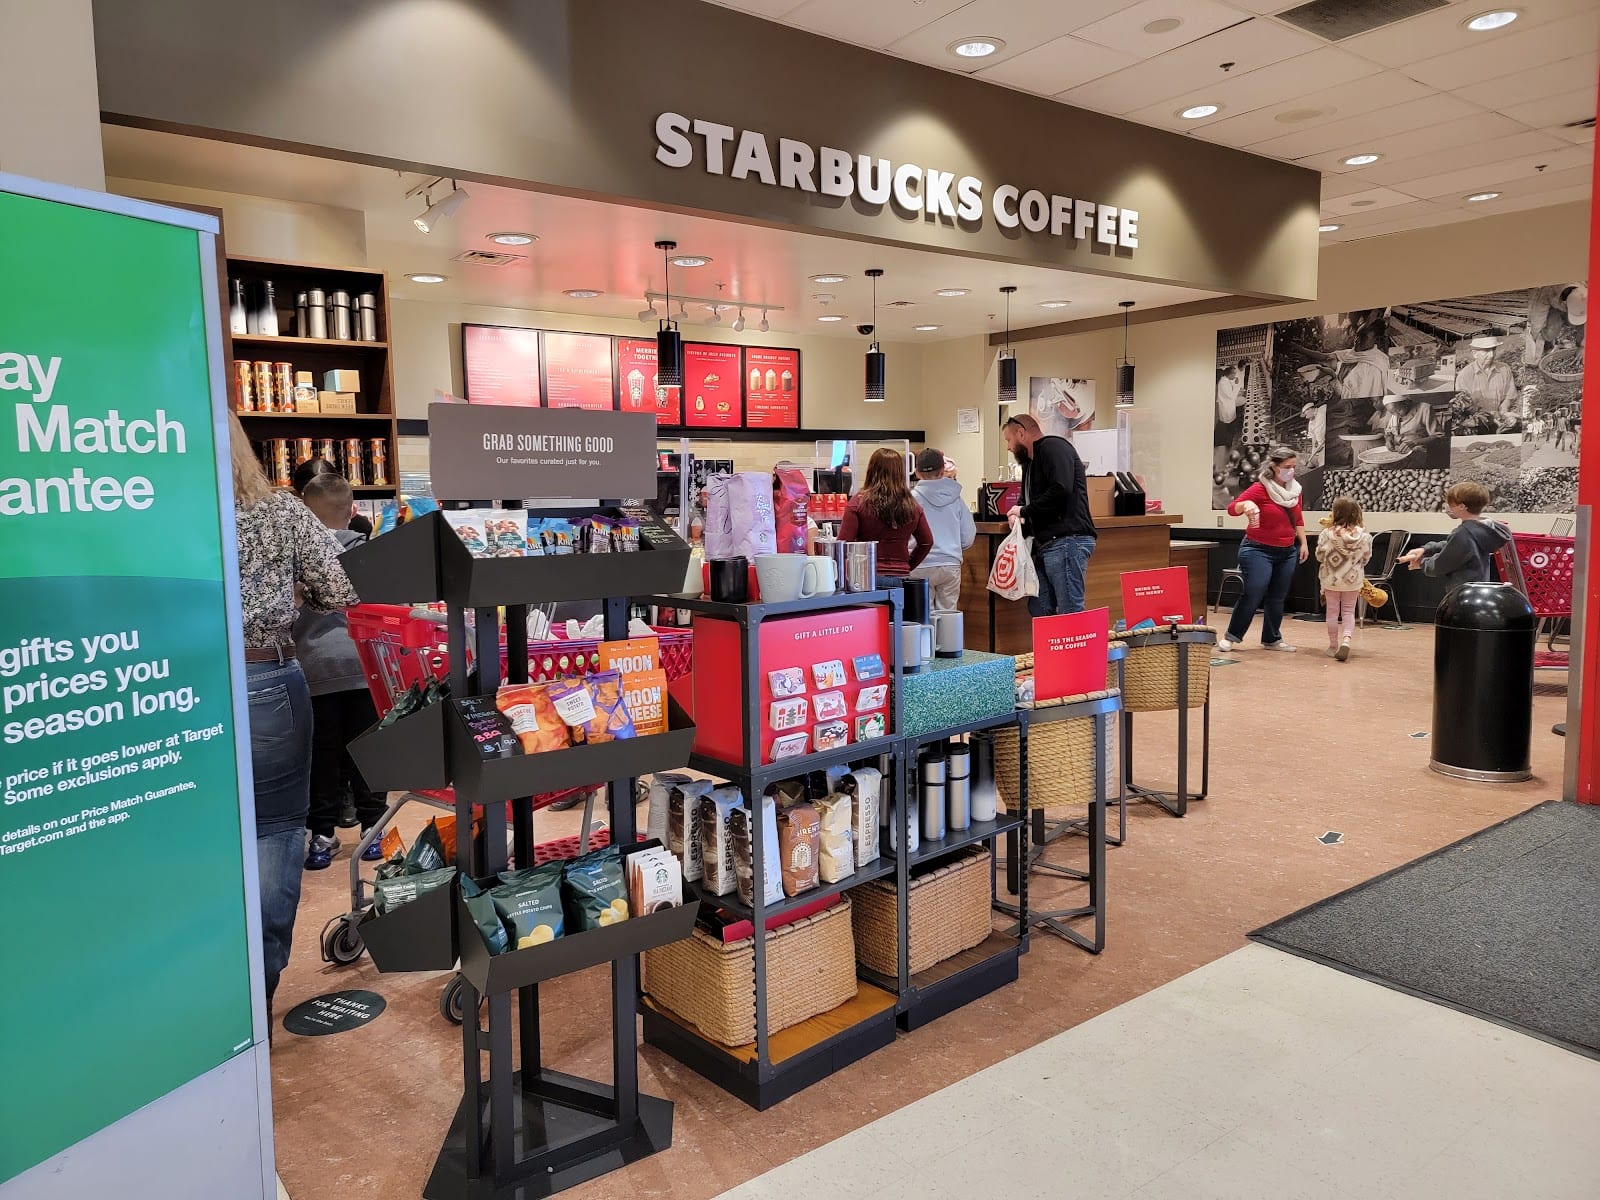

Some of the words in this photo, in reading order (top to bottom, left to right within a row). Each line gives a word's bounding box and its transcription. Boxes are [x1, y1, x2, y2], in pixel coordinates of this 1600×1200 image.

[655, 112, 984, 222] STARBUCKS
[992, 184, 1139, 249] COFFEE
[16, 403, 186, 454] Match
[483, 433, 514, 451] GRAB
[517, 434, 582, 452] SOMETHING
[585, 436, 614, 453] GOOD
[496, 456, 509, 464] Our
[510, 456, 539, 465] favorites
[539, 457, 564, 465] curated
[565, 458, 577, 467] just
[622, 533, 640, 541] KIND
[794, 631, 811, 641] GIFT
[812, 630, 818, 638] A
[818, 626, 840, 637] LITTLE
[841, 625, 854, 634] JOY
[1075, 632, 1097, 642] SEASON
[0, 637, 75, 677] gifts
[81, 630, 140, 662] you
[1064, 641, 1087, 650] COFFEE
[608, 654, 653, 674] MOON
[3, 669, 108, 714] prices
[115, 659, 170, 692] you
[3, 701, 124, 745] season
[132, 686, 200, 714] long.
[629, 704, 663, 722] HEESE
[473, 730, 502, 742] BBQ
[6, 767, 49, 790] price
[52, 761, 64, 776] if
[66, 757, 78, 772] it
[81, 750, 119, 772] goes
[121, 738, 163, 759] lower
[165, 734, 180, 748] at
[182, 722, 224, 743] Target
[4, 784, 54, 806] Some
[57, 763, 139, 792] exclusions
[142, 750, 183, 770] apply.
[2, 825, 41, 842] details
[43, 819, 58, 832] on
[60, 813, 80, 827] our
[81, 806, 109, 821] Price
[110, 794, 143, 811] Match
[145, 781, 197, 801] Guarantee,
[864, 797, 872, 847] ESPRESSO
[0, 830, 64, 856] Target.com
[66, 823, 88, 837] and
[88, 817, 106, 830] the
[108, 811, 131, 826] app.
[690, 808, 699, 861] ESPRESSO
[724, 816, 733, 872] ESPRESSO
[518, 899, 540, 908] SALTED
[312, 999, 331, 1009] FOR
[330, 1004, 371, 1019] WAITING
[333, 997, 370, 1011] THANKS
[317, 1010, 343, 1020] HERE
